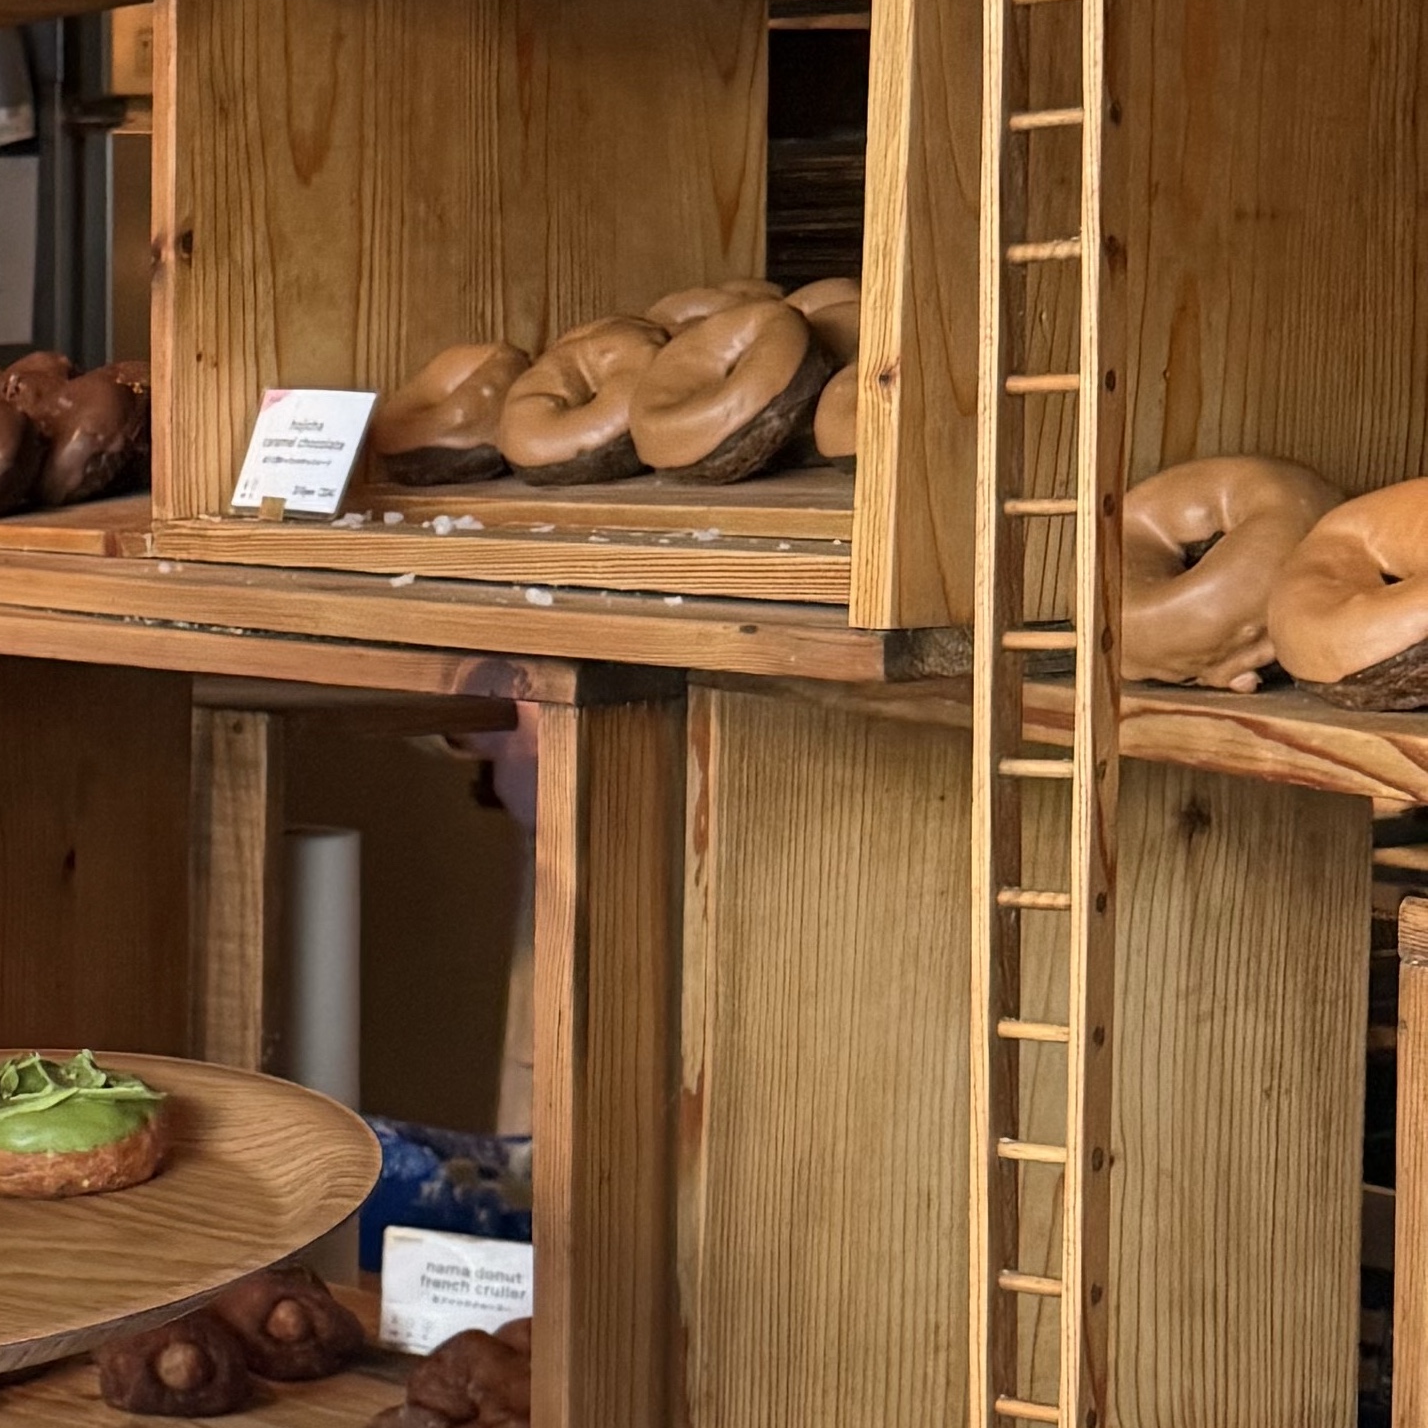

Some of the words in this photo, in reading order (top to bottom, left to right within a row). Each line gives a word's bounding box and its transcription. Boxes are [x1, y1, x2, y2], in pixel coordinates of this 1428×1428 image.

[426, 1262, 471, 1277] nama
[475, 1266, 523, 1284] donut
[420, 1275, 471, 1293] french
[475, 1283, 526, 1300] cruller
